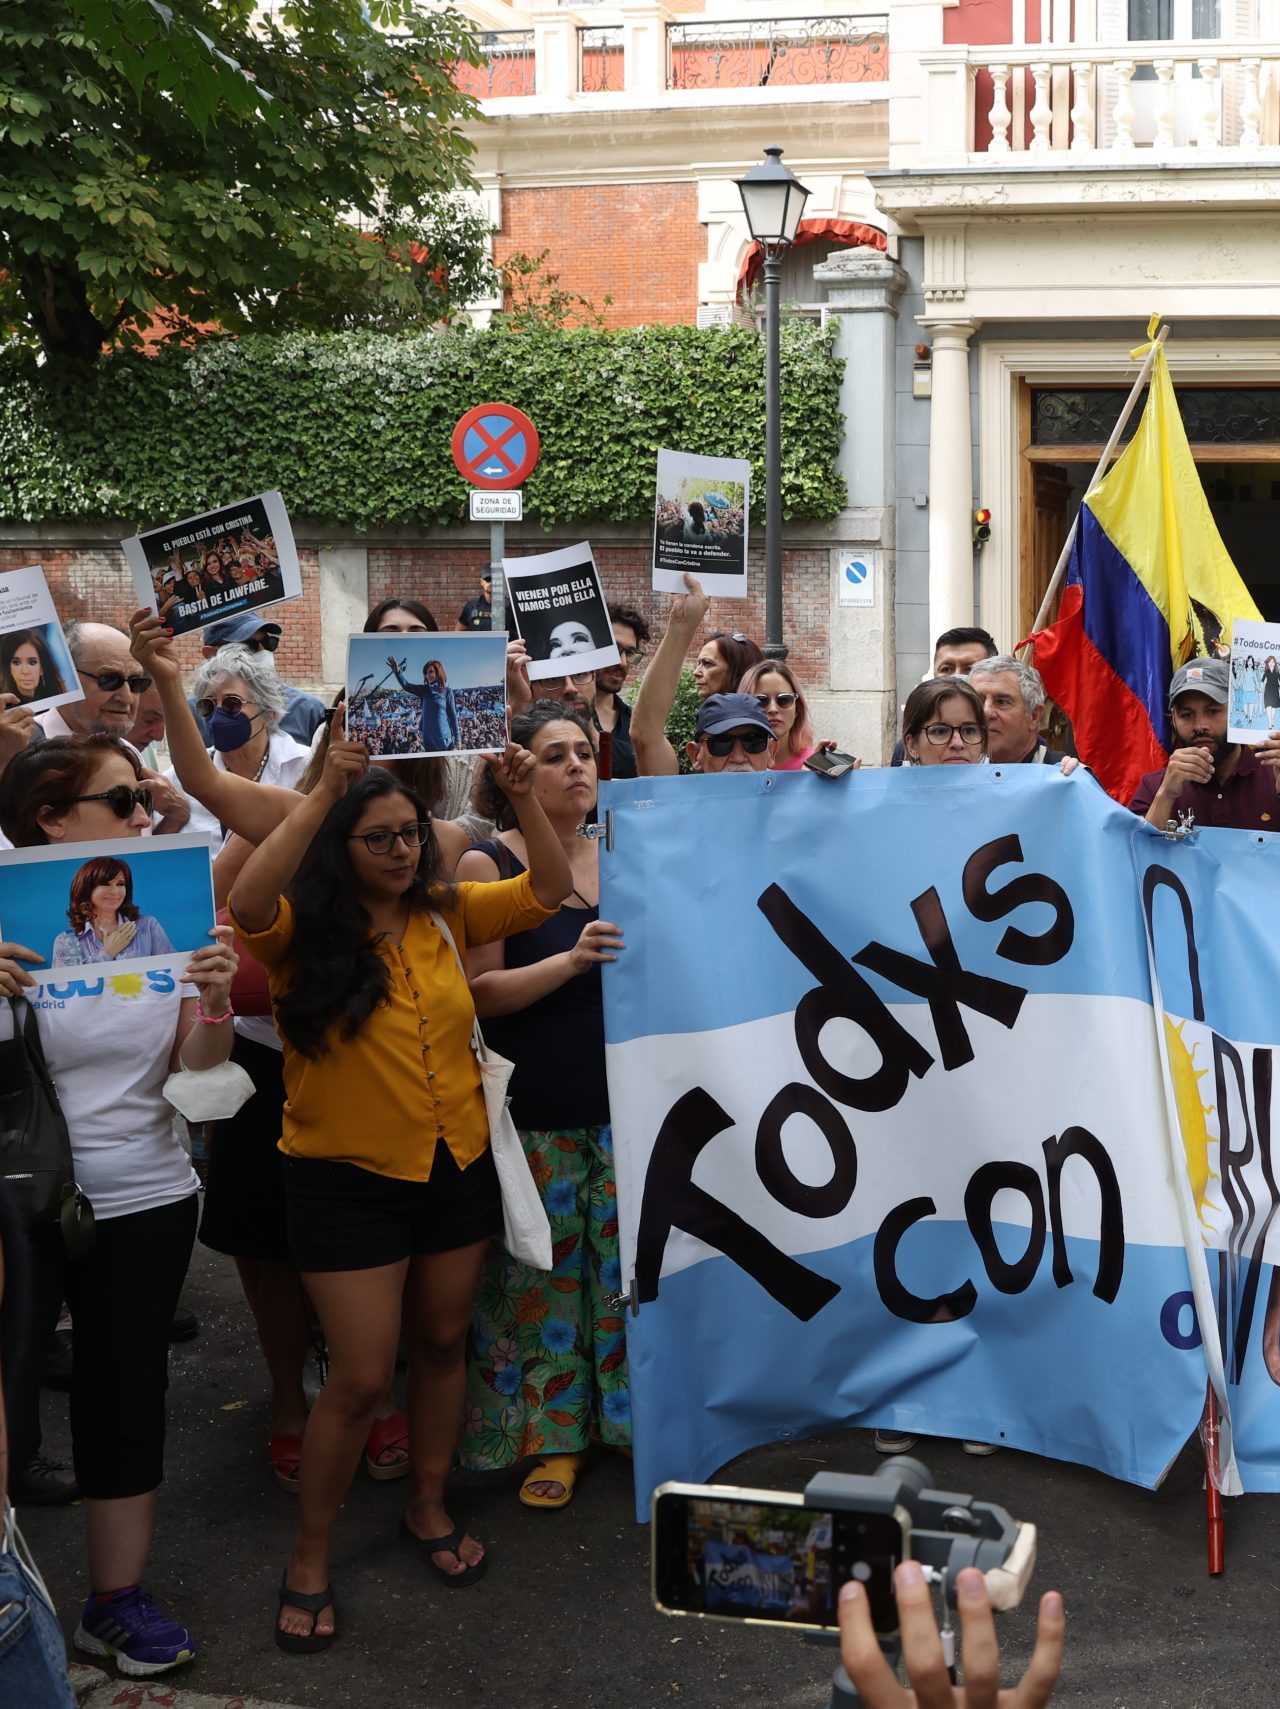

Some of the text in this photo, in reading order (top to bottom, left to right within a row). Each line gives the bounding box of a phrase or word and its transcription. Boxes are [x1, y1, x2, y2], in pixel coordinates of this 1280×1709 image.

[163, 514, 253, 551] EL PUEBLO ESTÁ CON CRISTINA
[703, 549, 731, 557] defender.
[178, 578, 269, 617] BASTA DE LAWFARE.
[516, 577, 593, 601] VIENEN POR ELLA
[518, 588, 596, 612] VAMOS CON ELLA
[634, 833, 1074, 1323] Todxs
[872, 1124, 1126, 1325] con
